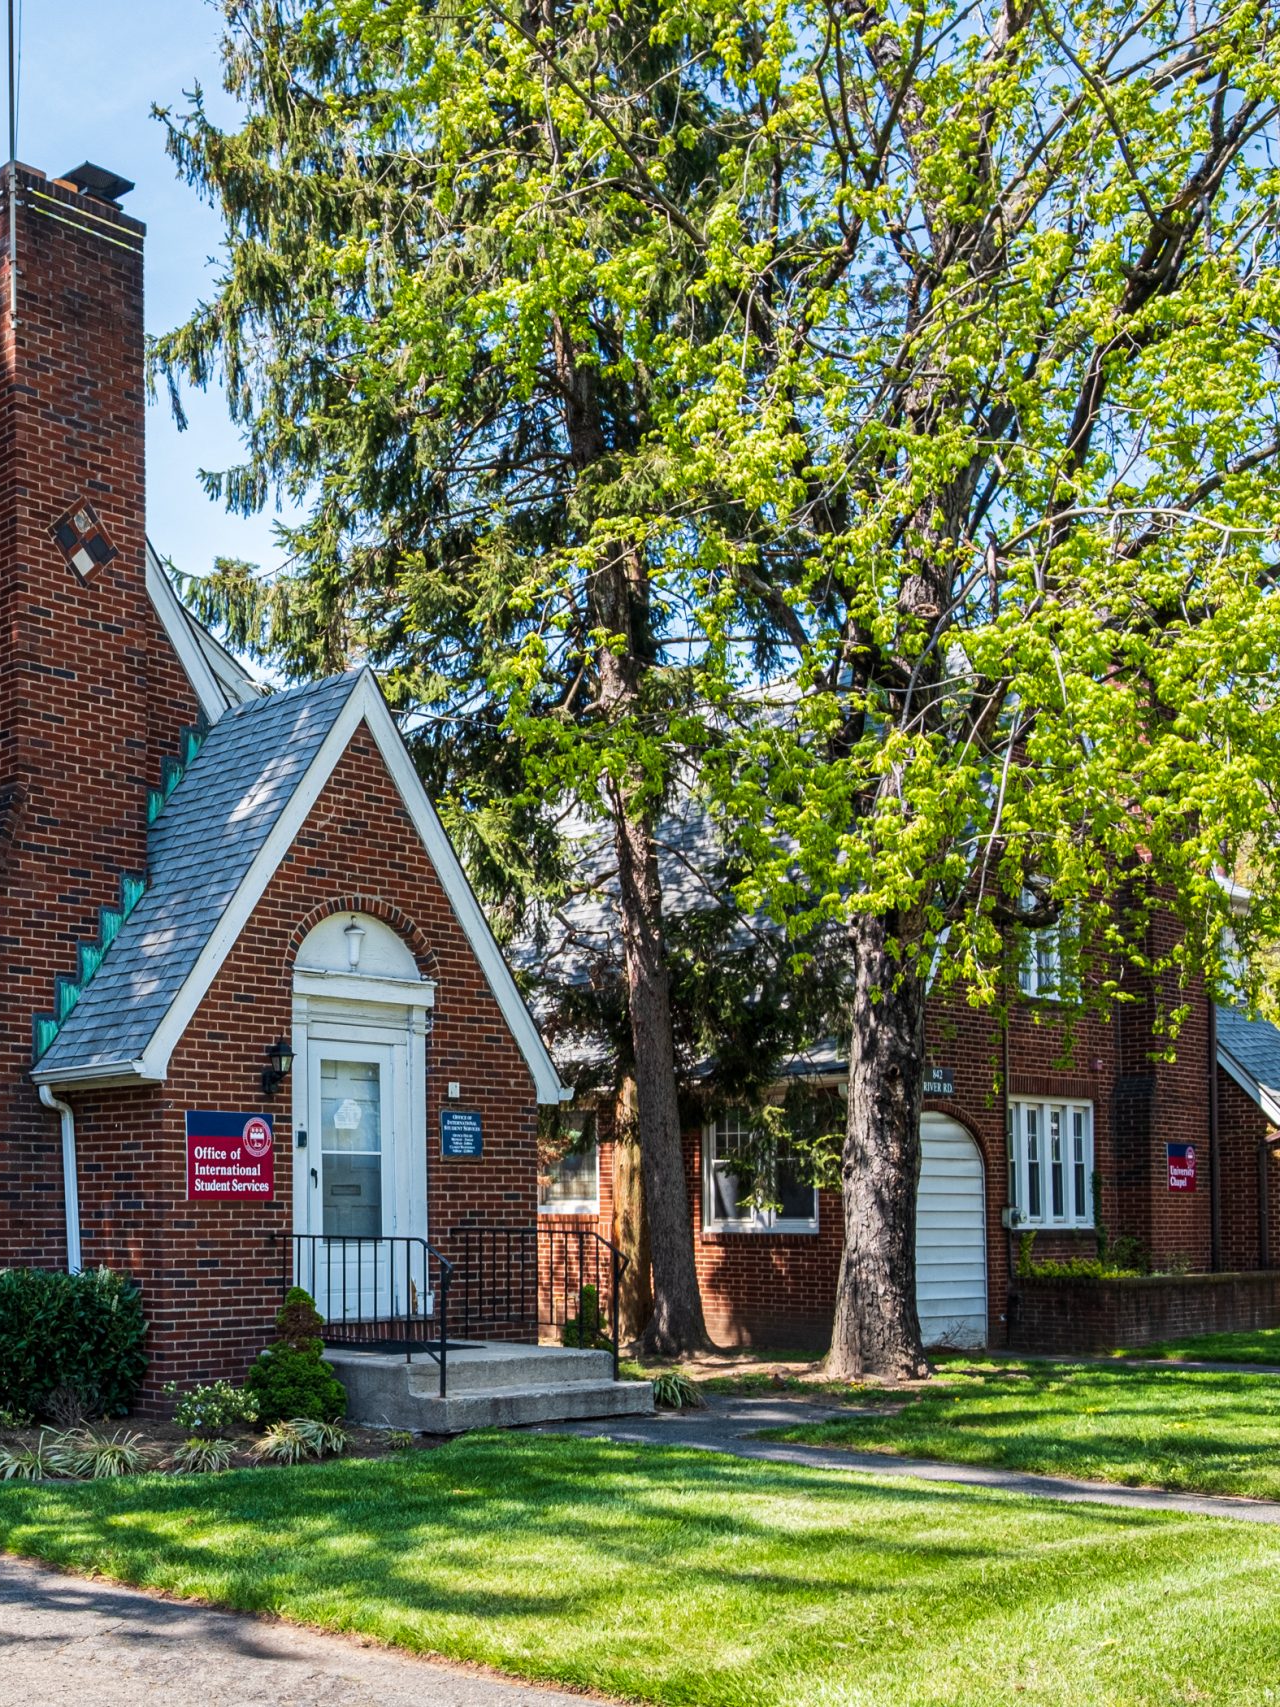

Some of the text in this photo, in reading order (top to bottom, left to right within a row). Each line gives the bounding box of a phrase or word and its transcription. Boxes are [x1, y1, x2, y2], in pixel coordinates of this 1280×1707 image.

[923, 1081, 941, 1093] RIVER
[194, 1146, 241, 1160] Office of
[194, 1162, 261, 1176] International
[1170, 1165, 1194, 1178] University
[194, 1178, 269, 1192] Student Services
